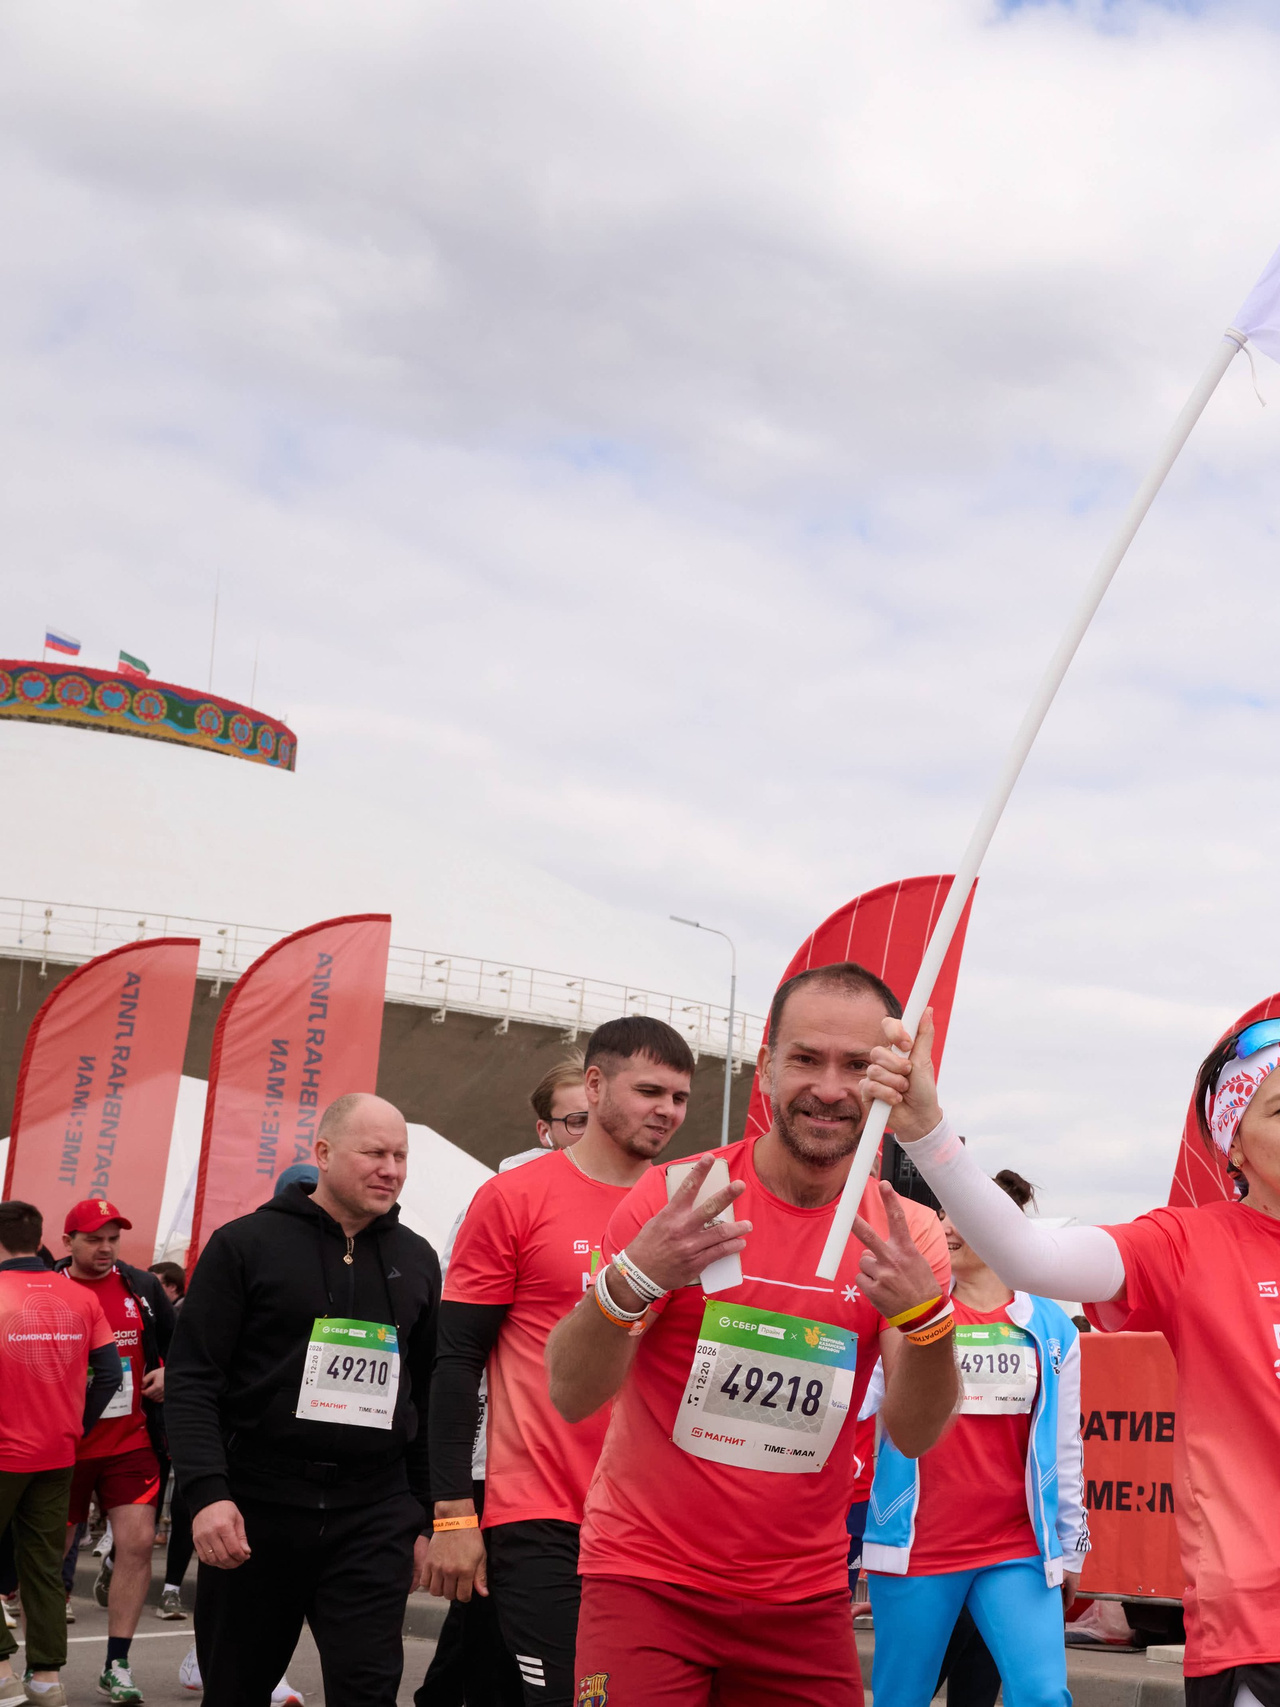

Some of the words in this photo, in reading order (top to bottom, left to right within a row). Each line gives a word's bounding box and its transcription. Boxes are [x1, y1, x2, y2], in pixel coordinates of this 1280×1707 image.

[732, 1320, 757, 1331] СБЕР
[8, 1333, 52, 1342] Команда
[697, 1345, 717, 1357] 2026
[310, 1355, 319, 1374] 12:20
[326, 1355, 388, 1386] 49210
[961, 1353, 1020, 1374] 49189
[696, 1361, 711, 1390] 12:20
[720, 1364, 823, 1416] 49218
[319, 1401, 347, 1410] МАГНИТ
[704, 1431, 746, 1446] МАГНИТ
